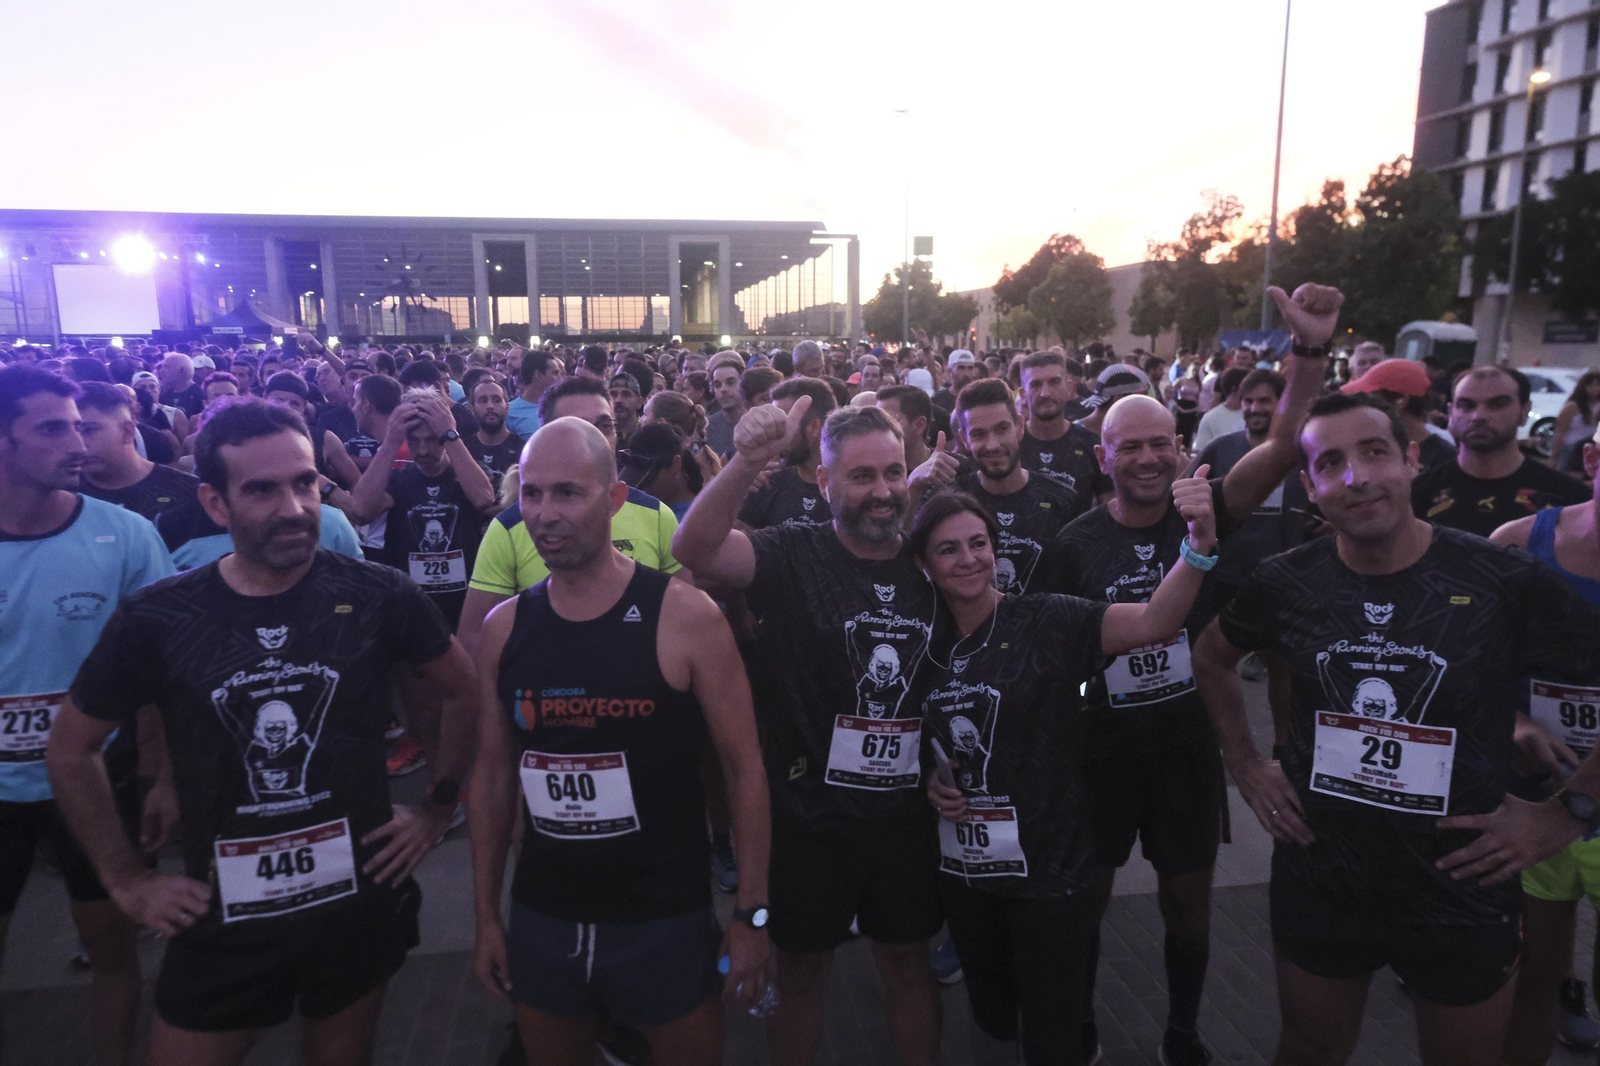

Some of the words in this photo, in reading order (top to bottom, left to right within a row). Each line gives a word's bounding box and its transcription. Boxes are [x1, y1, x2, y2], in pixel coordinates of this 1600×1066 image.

[423, 561, 449, 576] 228
[873, 584, 896, 596] Rock
[876, 607, 894, 616] the
[1363, 602, 1395, 616] Rock
[854, 611, 893, 631] Running
[892, 614, 924, 629] Stones
[256, 625, 289, 641] Rock
[1360, 631, 1386, 643] the
[1328, 639, 1383, 662] Running
[1382, 641, 1429, 660] Stones
[1128, 650, 1171, 677] 692
[224, 671, 281, 687] Running
[541, 687, 587, 697] CÓRDOBA
[540, 697, 657, 718] PROYECTO
[1560, 701, 1600, 730] 98
[2, 708, 51, 735] 273
[542, 716, 598, 728] HOMBRE
[1358, 723, 1378, 734] ROCK
[1379, 728, 1393, 737] FM
[1393, 730, 1410, 739] 500
[861, 733, 901, 759] 675
[1360, 736, 1402, 770] 29
[546, 773, 596, 801] 640
[956, 823, 989, 847] 676
[257, 847, 315, 880] 446
